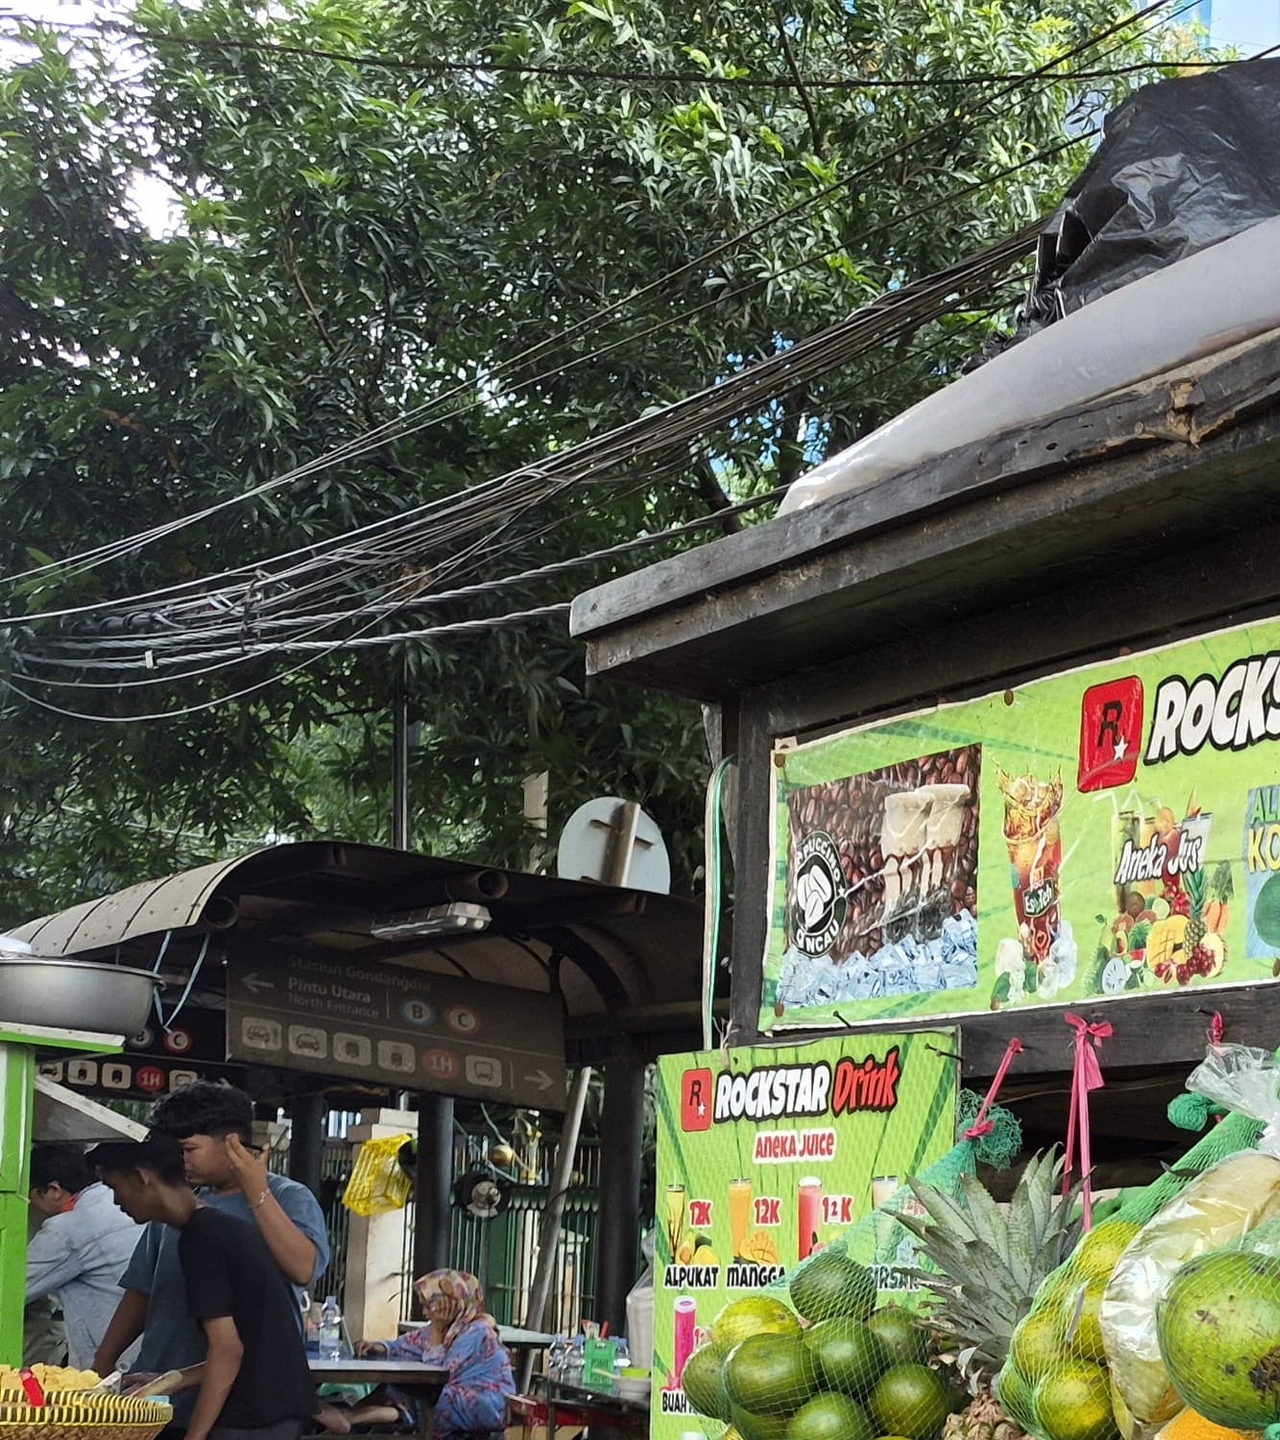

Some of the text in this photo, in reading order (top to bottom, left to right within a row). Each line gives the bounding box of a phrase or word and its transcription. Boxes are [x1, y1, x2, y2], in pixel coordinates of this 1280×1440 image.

[1115, 829, 1202, 883] Aneka Jus
[288, 976, 371, 1004] Pintu Utara
[714, 1061, 831, 1122] ROCKSTAR
[832, 1045, 900, 1118] Drink
[754, 1199, 780, 1225] 12K
[665, 1266, 719, 1288] ALPUKAT
[662, 1392, 687, 1413] BUAH
